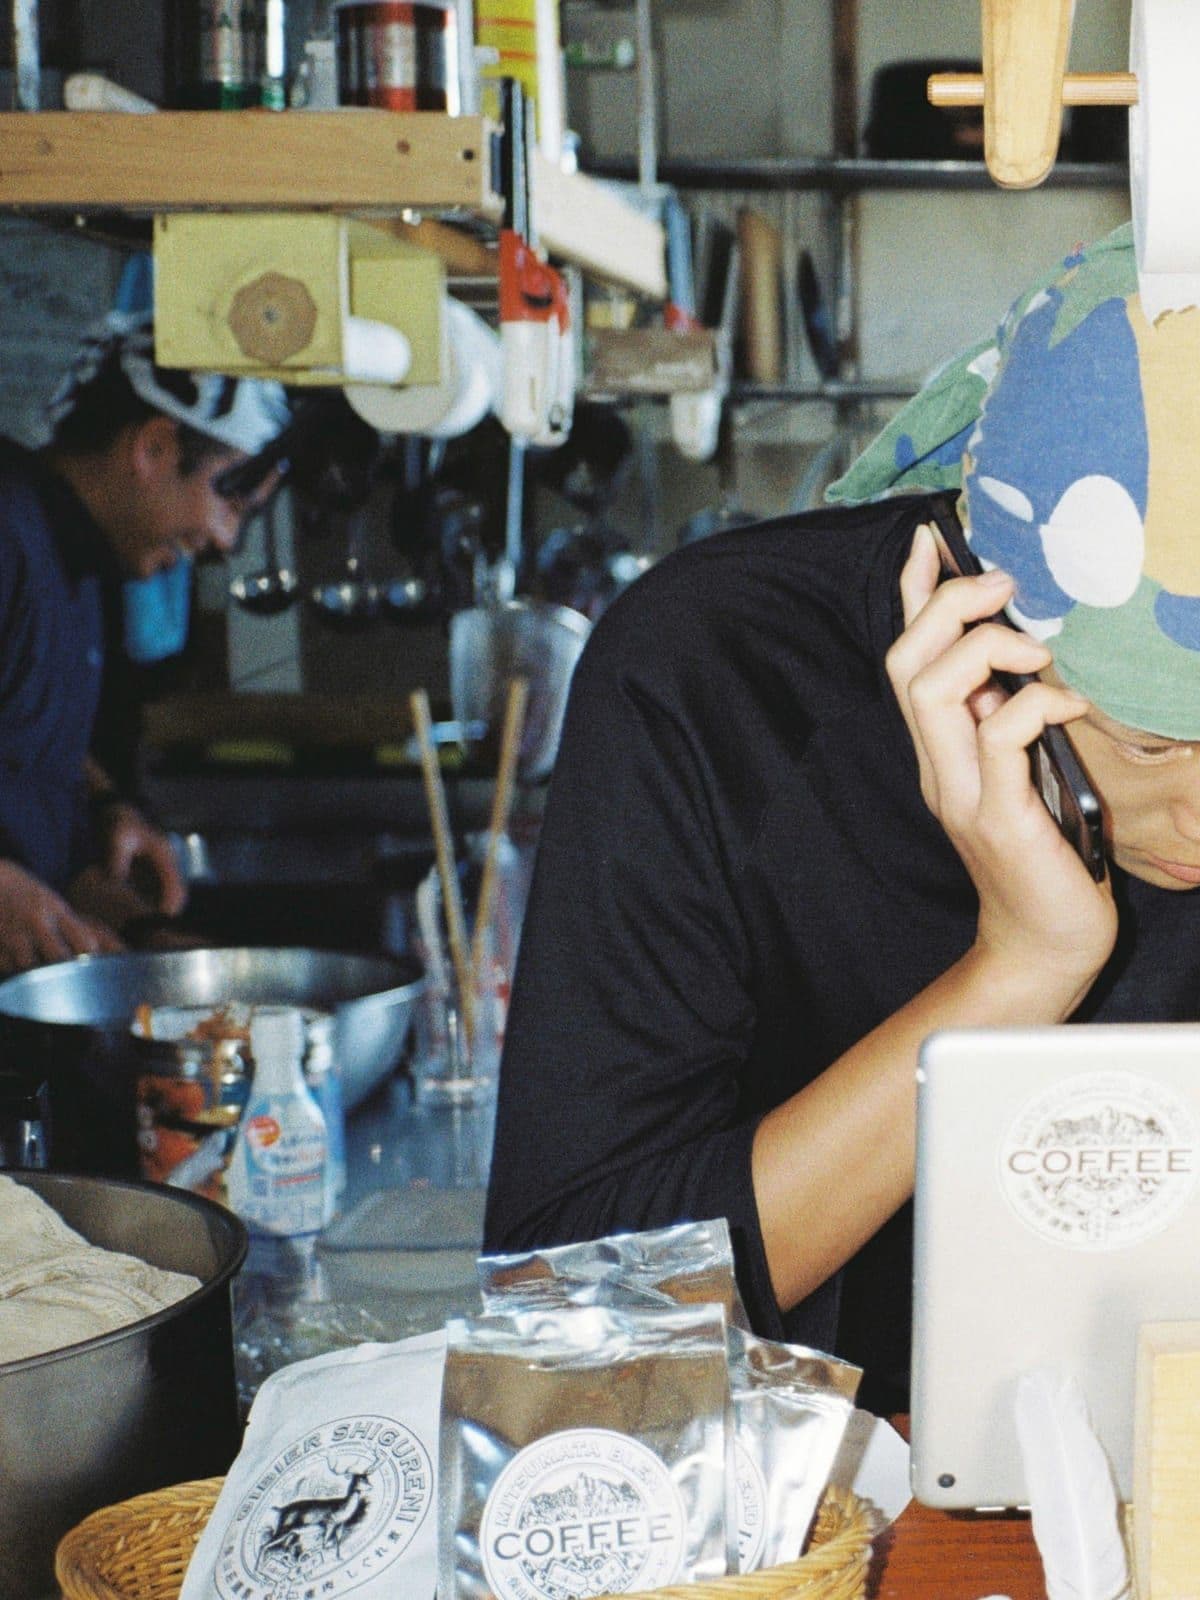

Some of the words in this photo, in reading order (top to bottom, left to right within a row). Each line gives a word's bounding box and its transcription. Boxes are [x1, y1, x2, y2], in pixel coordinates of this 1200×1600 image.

[1008, 1149, 1193, 1174] COFFEE
[331, 1420, 425, 1524] SHIGURENI
[495, 1442, 601, 1528] MITSUMATA
[493, 1513, 675, 1561] COFFEE
